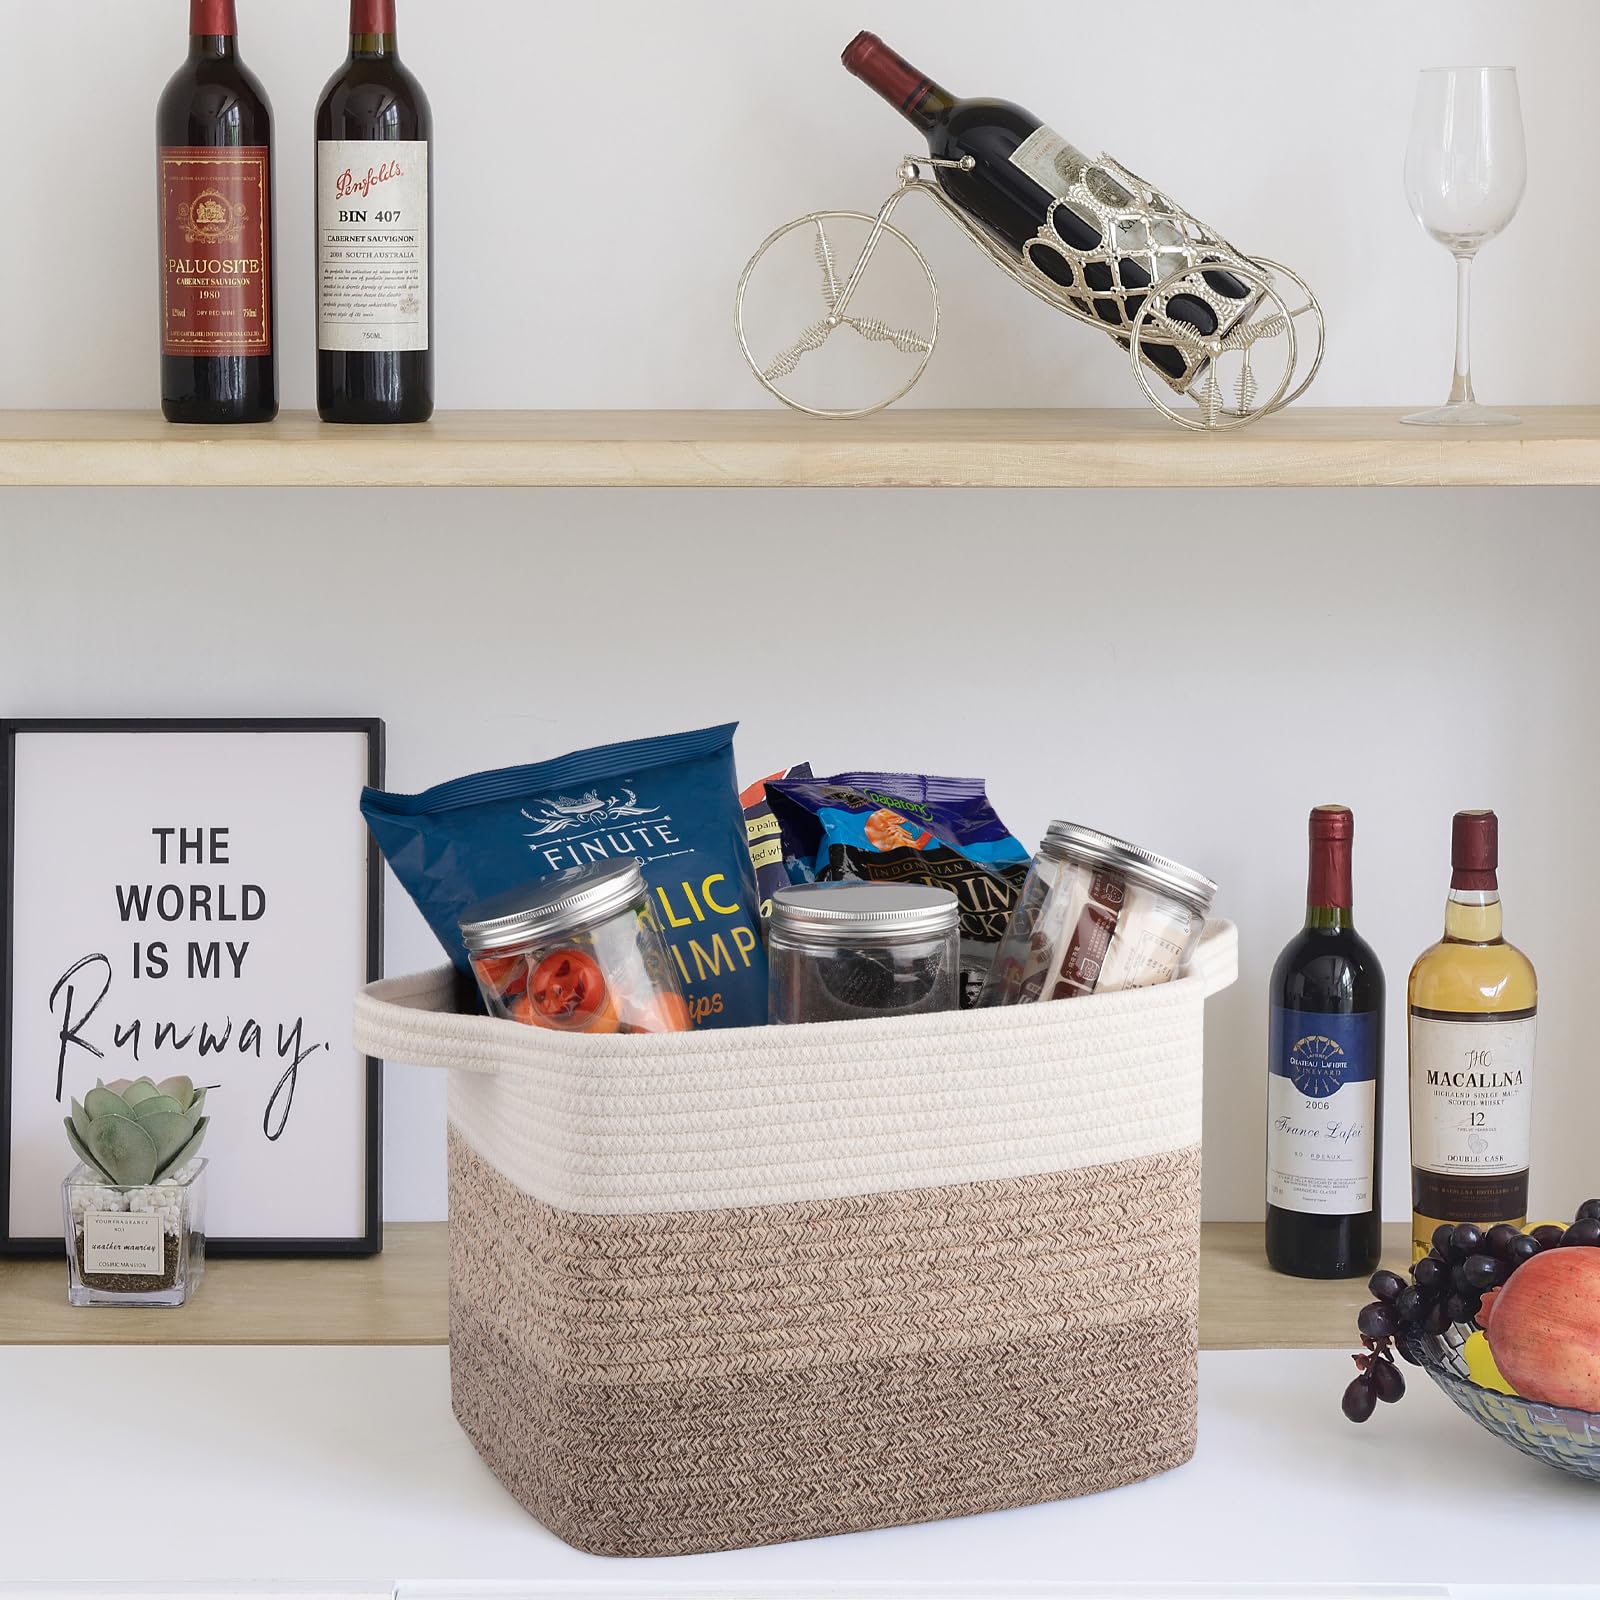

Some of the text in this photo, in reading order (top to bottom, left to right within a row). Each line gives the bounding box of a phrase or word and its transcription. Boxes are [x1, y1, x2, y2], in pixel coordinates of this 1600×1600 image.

[339, 210, 401, 222] BIN 407
[168, 258, 260, 274] PALUOSITE
[176, 277, 250, 286] CABERNET SAUVIGNON
[200, 290, 220, 299] 1980
[152, 827, 230, 865] THE
[542, 824, 680, 871] FINUTE
[115, 884, 267, 922] WORLD
[655, 873, 740, 928] LIC
[133, 941, 250, 979] IS MY
[670, 926, 756, 985] IMP
[687, 992, 724, 1025] ips
[49, 953, 329, 1141] Runway.
[1296, 1065, 1341, 1076] VINEYARD
[1427, 1069, 1523, 1088] MACALLNA
[1305, 1100, 1330, 1110] 2006
[1274, 1115, 1364, 1144] France Lafei
[1471, 1112, 1485, 1126] 12
[1447, 1154, 1504, 1162] DOUBLE CASK
